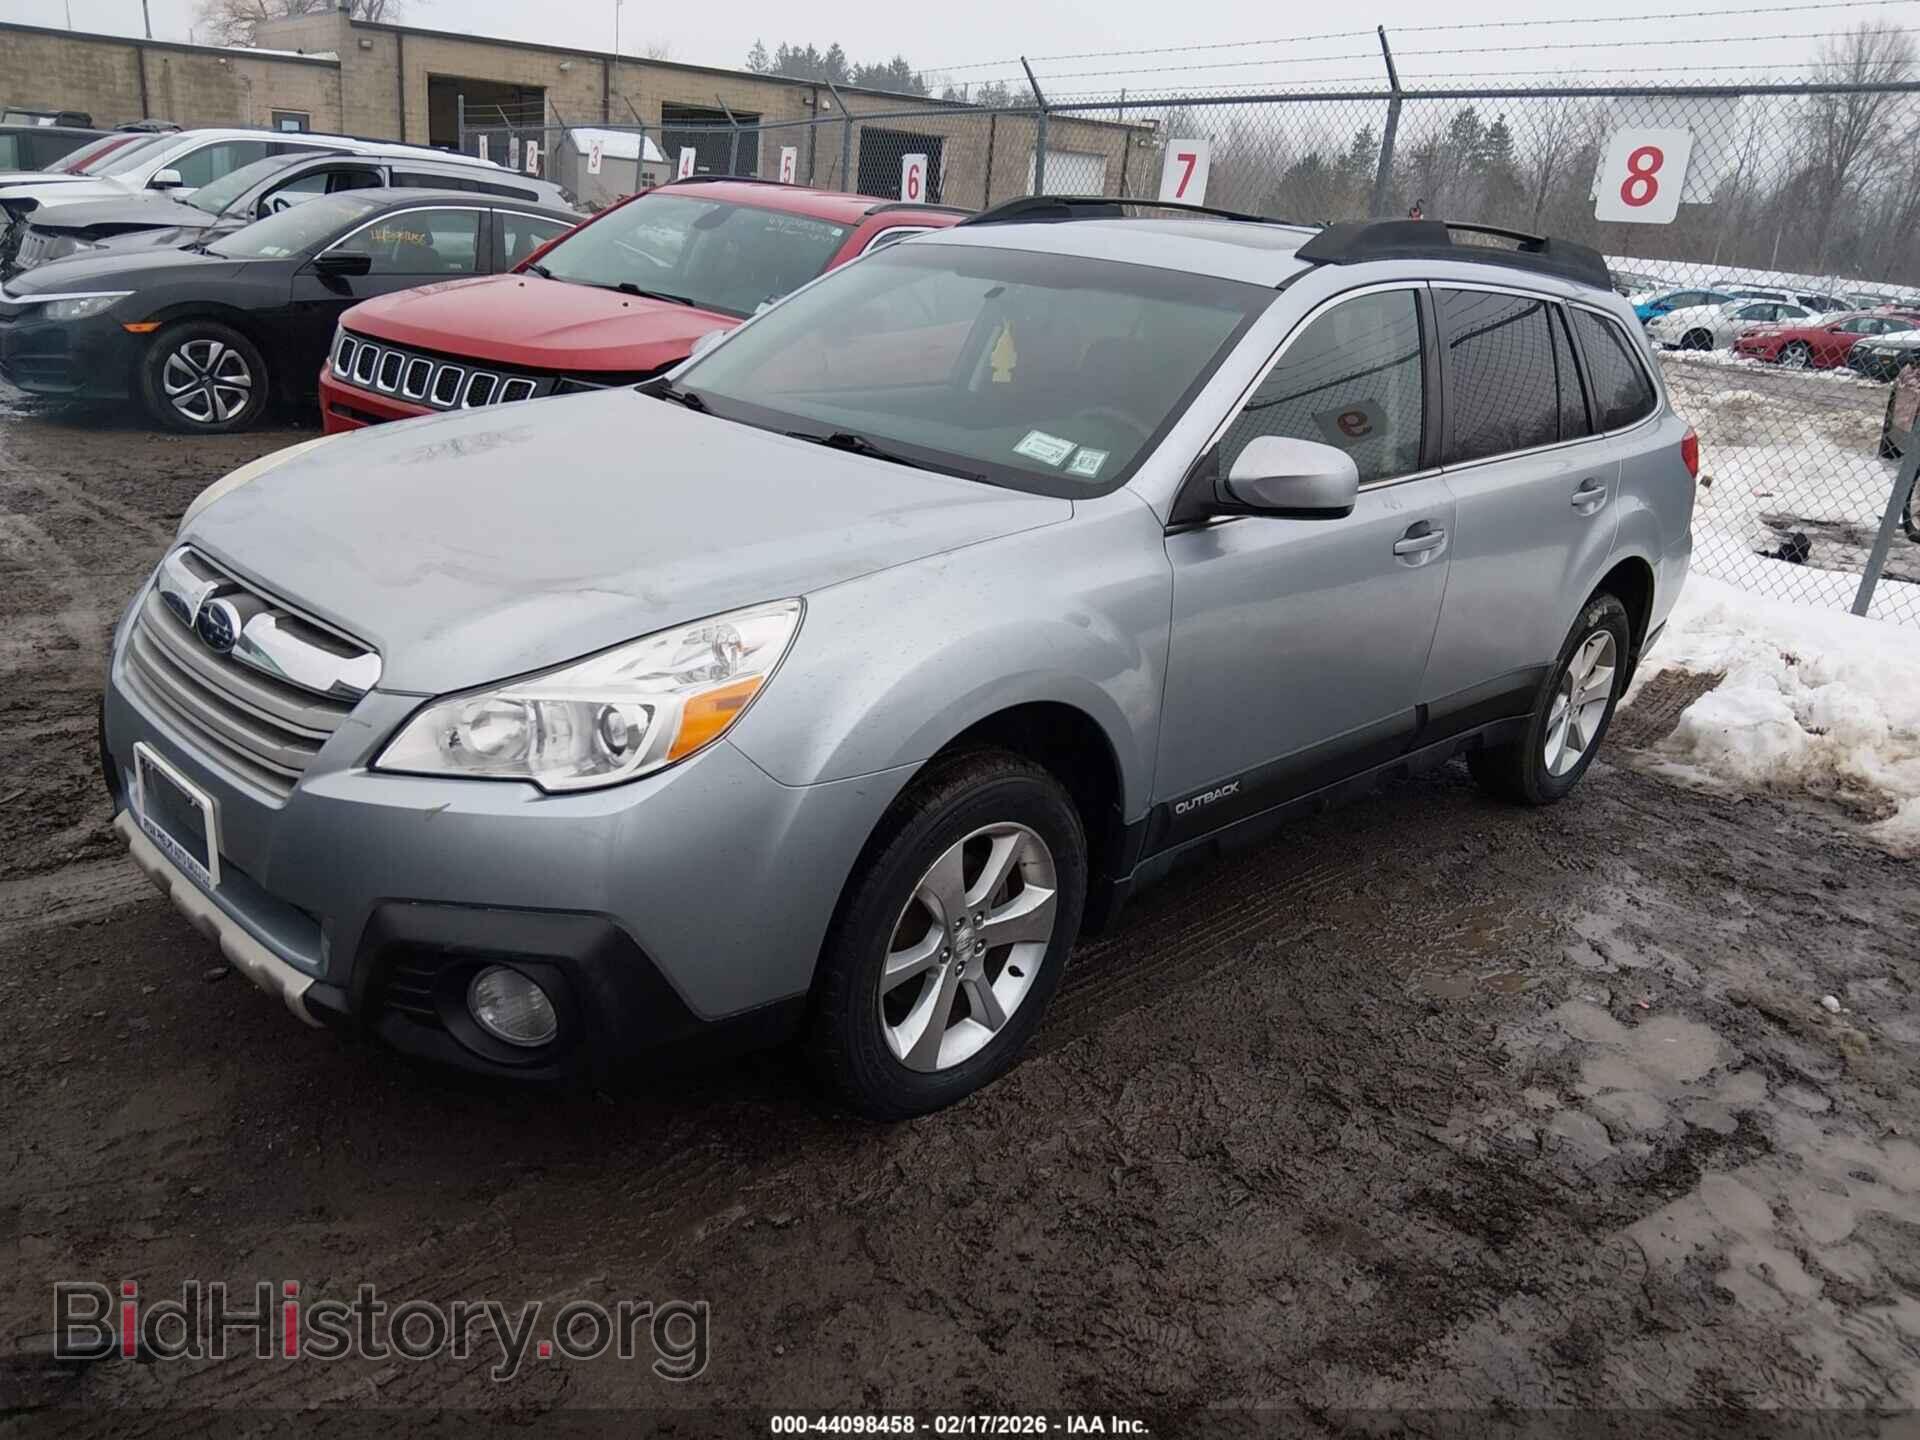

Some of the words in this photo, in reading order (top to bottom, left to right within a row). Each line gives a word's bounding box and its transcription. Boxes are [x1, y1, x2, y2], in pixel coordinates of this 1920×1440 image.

[528, 146, 535, 167] 2
[592, 145, 599, 168] 3
[682, 156, 690, 176] 4
[784, 156, 792, 183] 5
[908, 164, 919, 199] 6
[1176, 152, 1197, 198] 7
[1620, 145, 1664, 207] 8
[1175, 780, 1241, 815] OUTBACK
